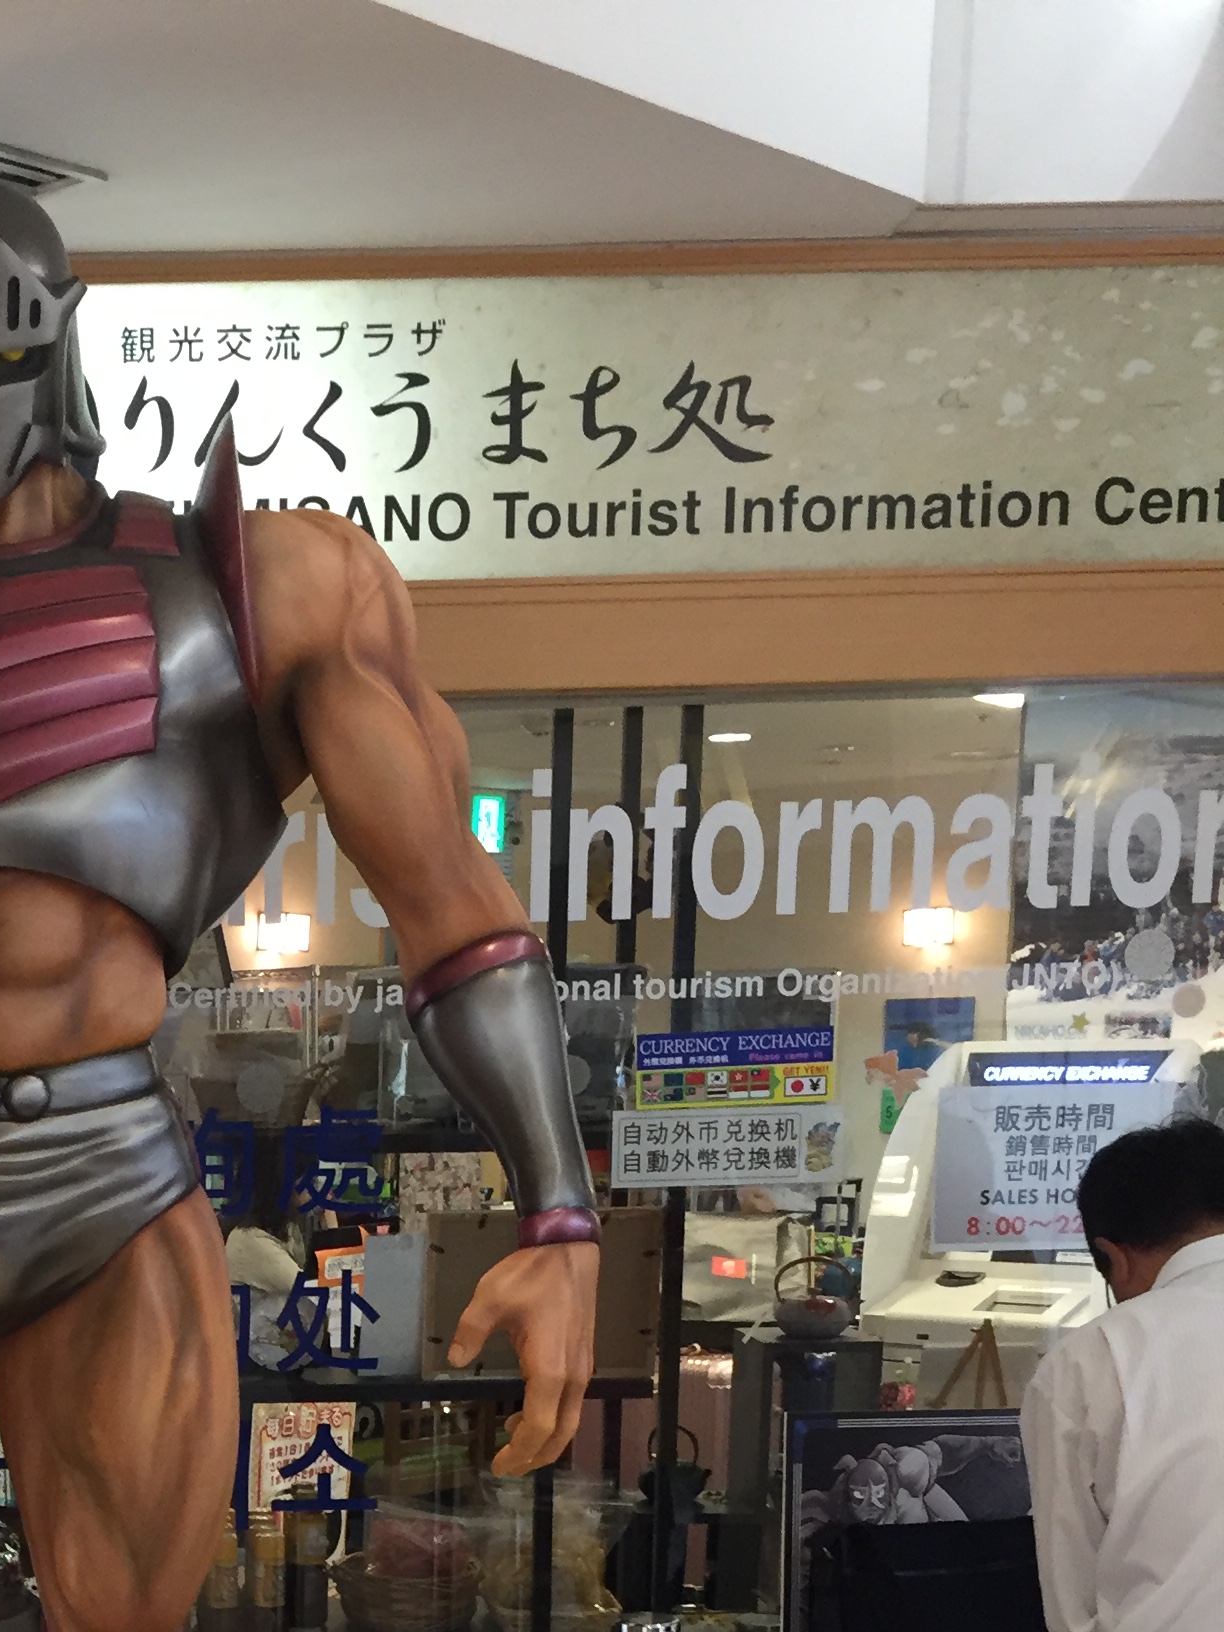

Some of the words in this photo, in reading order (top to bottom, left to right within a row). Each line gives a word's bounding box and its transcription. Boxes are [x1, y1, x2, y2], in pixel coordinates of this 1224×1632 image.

[120, 318, 448, 364] 観光交流プラザ
[123, 358, 776, 474] りんくうまち処
[493, 489, 702, 541] Tourist
[724, 479, 1071, 535] Information
[325, 979, 364, 1014] by
[633, 971, 765, 1002] tourism
[640, 1035, 731, 1056] CURRENCY
[738, 1031, 832, 1051] EXCHANGE
[749, 1052, 780, 1062] Please
[782, 1066, 801, 1077] GET
[983, 1066, 1065, 1083] CURRENCY
[1066, 1065, 1152, 1082] EXCHANGE
[993, 1103, 1115, 1133] 販売時間
[623, 1118, 798, 1146] 自动外币兑换机
[1004, 1134, 1098, 1157] 銷售時間
[979, 1189, 1039, 1206] SALES
